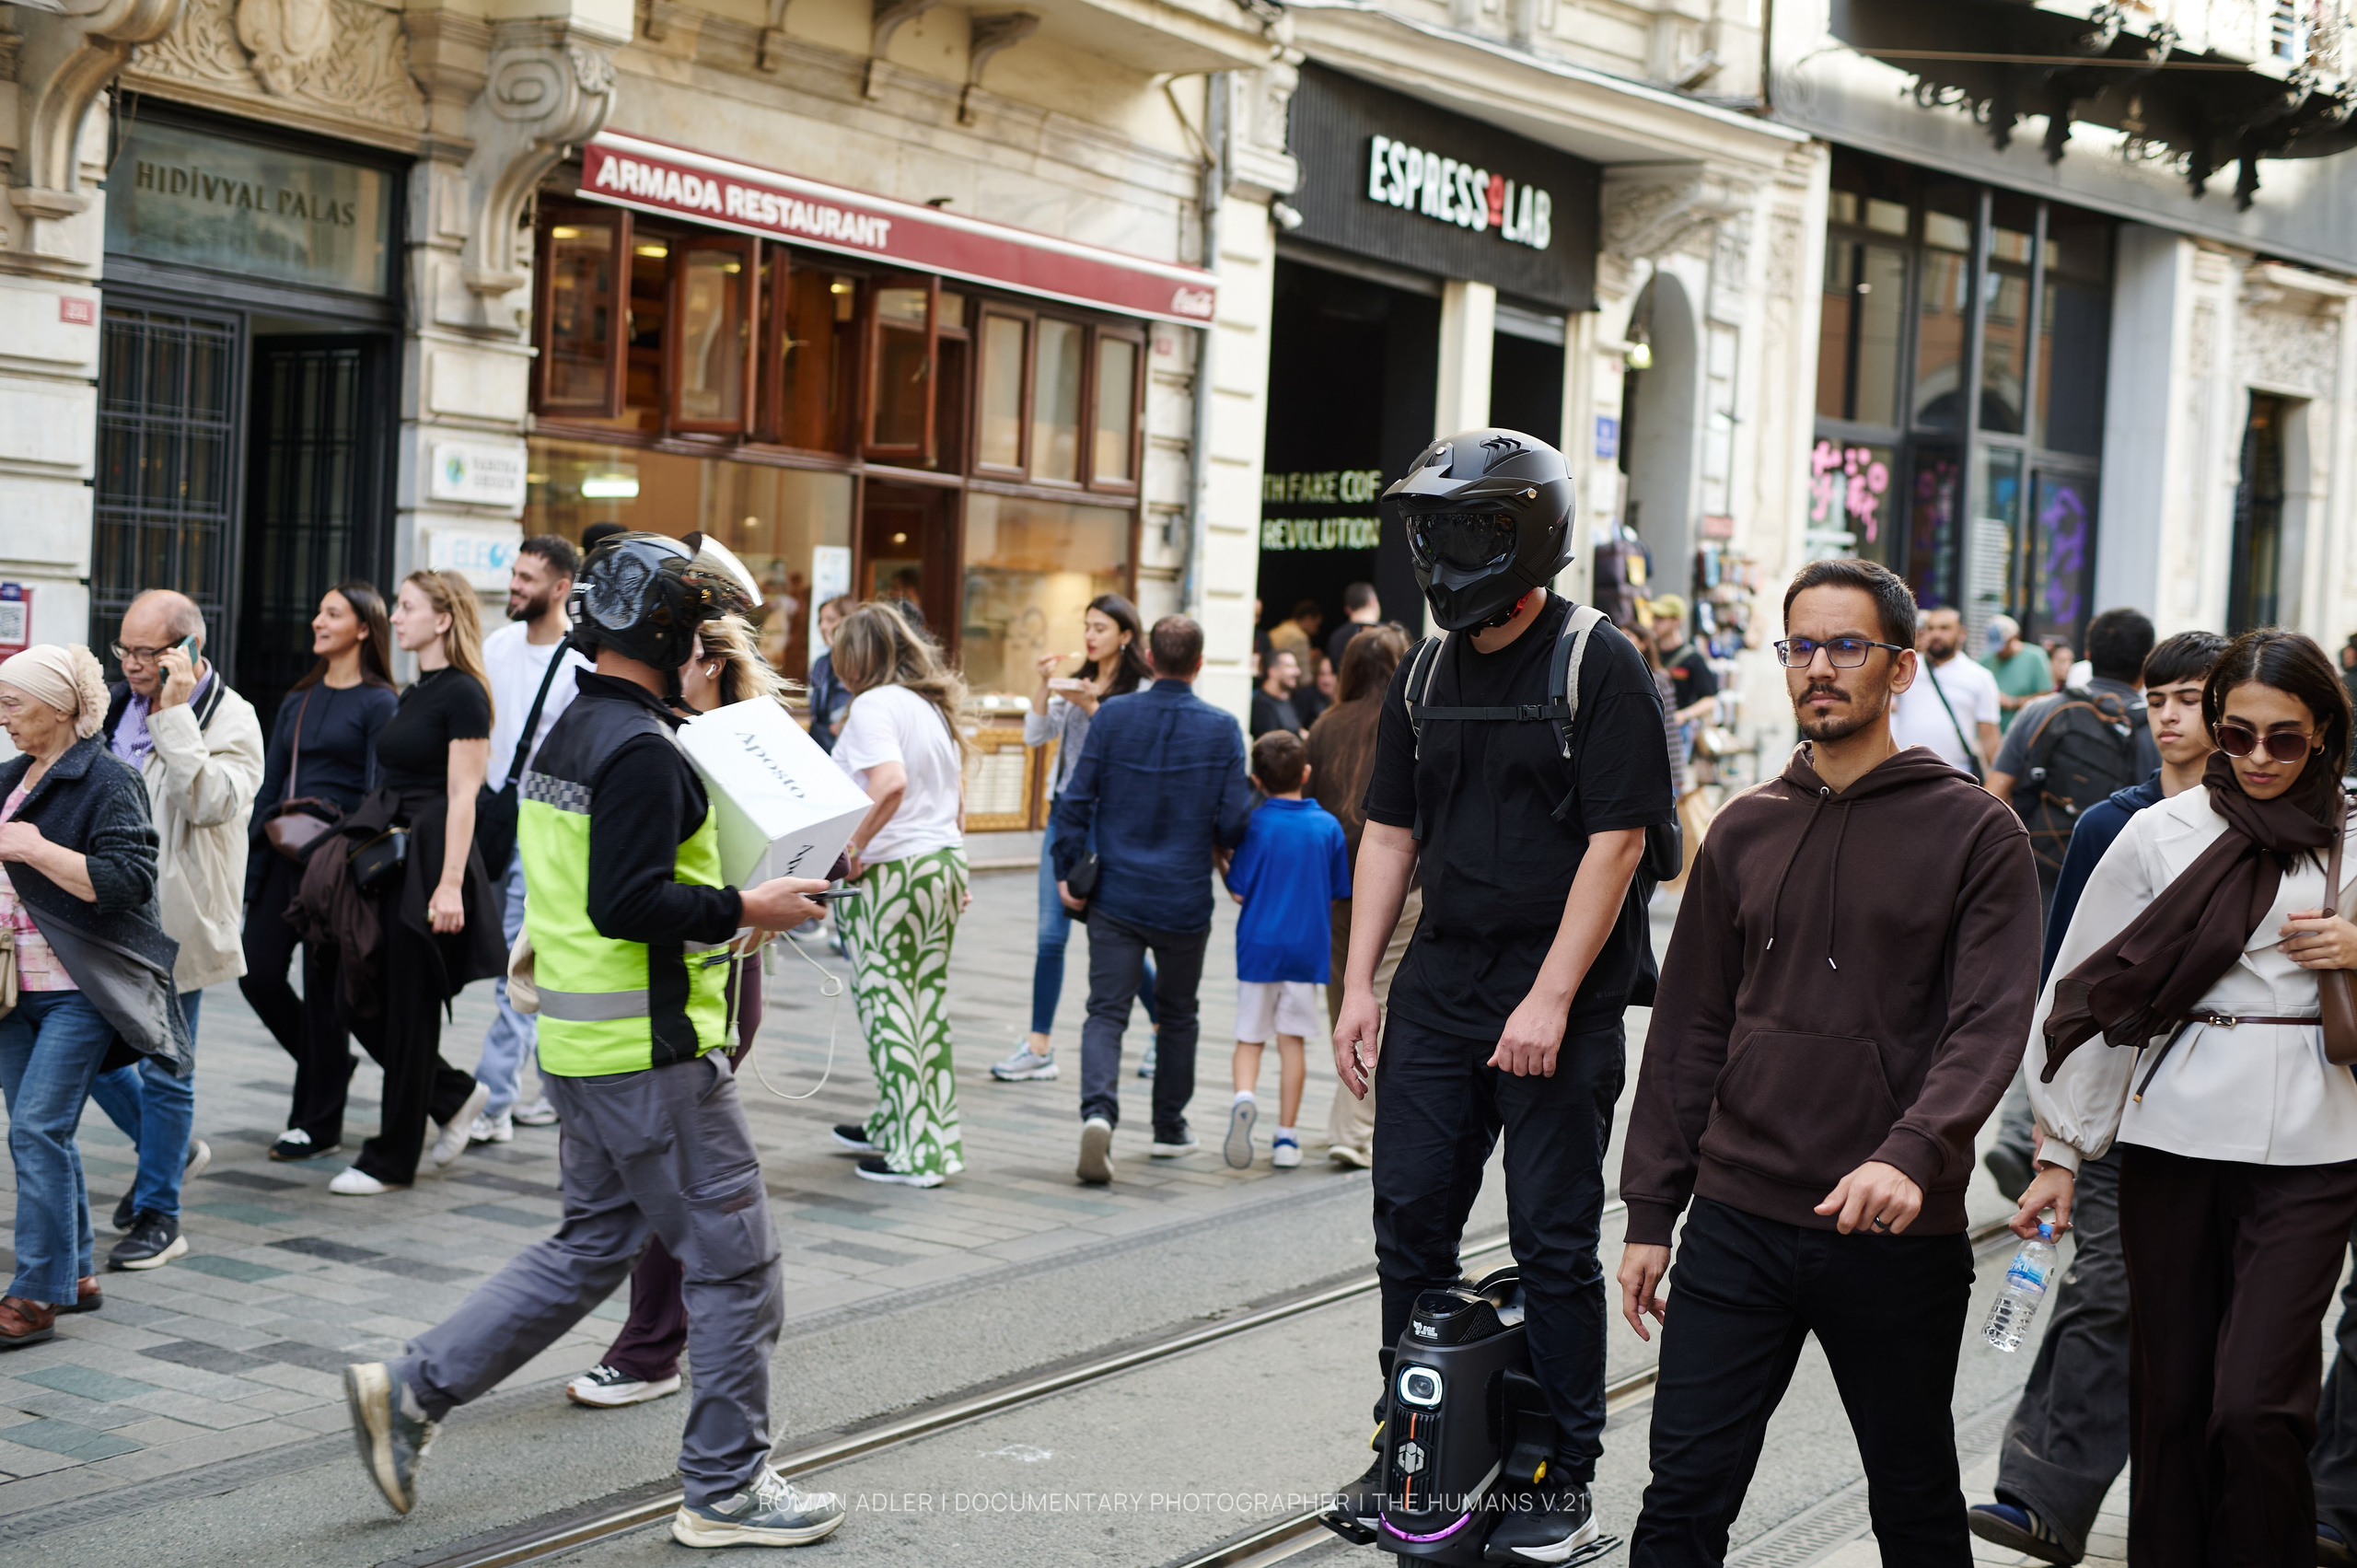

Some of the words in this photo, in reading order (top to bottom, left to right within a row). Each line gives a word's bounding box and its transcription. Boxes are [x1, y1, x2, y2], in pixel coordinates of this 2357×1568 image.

[136, 159, 269, 213] HIDİVYAL
[277, 188, 355, 227] PALAS
[595, 155, 724, 214] ARMADA
[725, 184, 892, 250] RESTAURANT
[1263, 472, 1285, 504] TH
[1287, 470, 1340, 504] FAKE
[1340, 469, 1383, 504] COF
[1261, 517, 1381, 551] REVOLUTION
[734, 731, 807, 799] Aposto
